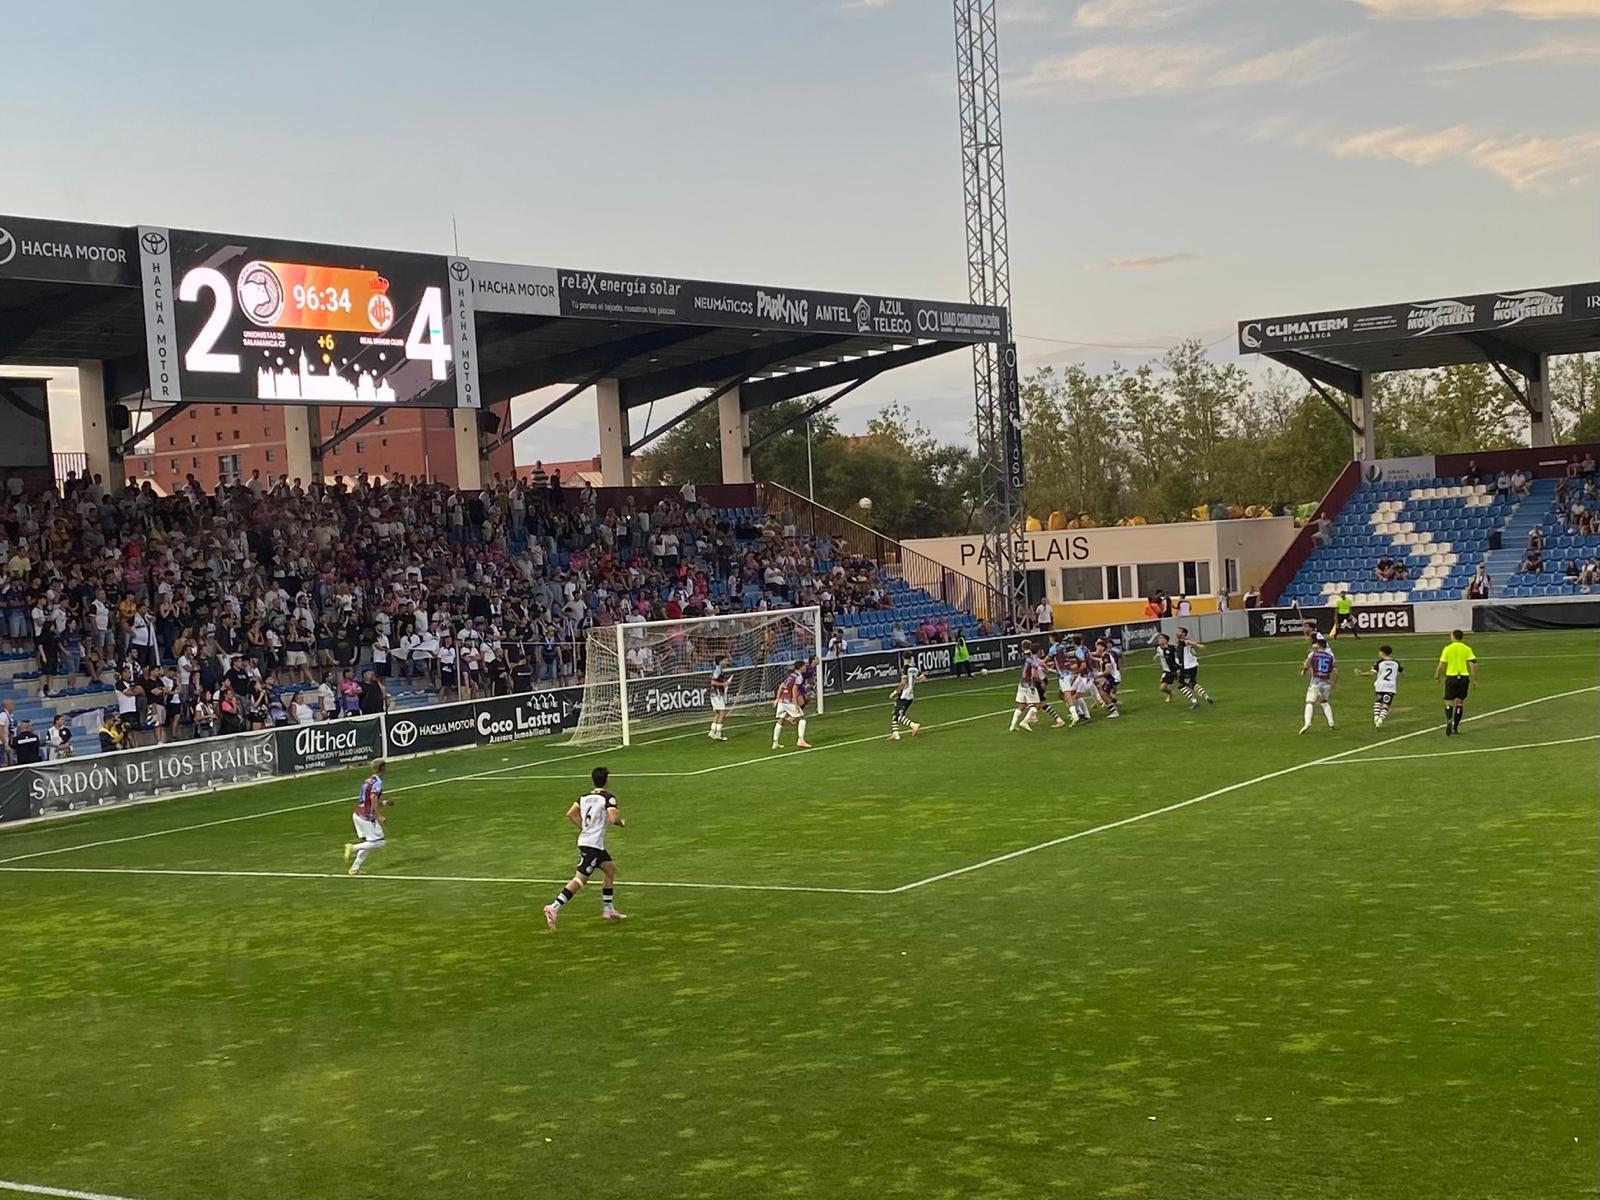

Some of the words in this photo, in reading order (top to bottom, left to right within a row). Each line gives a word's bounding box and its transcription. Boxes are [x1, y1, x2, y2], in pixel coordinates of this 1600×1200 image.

[22, 240, 73, 259] HACHA
[76, 246, 127, 263] MOTOR
[152, 262, 165, 325] HACHA
[478, 280, 516, 295] HACHA
[518, 283, 556, 298] MOTOR
[561, 273, 599, 296] relaX
[600, 277, 646, 297] energía
[650, 282, 681, 296] solar
[292, 284, 352, 313] 96:34
[694, 295, 753, 315] NEUMÁTICOS
[879, 299, 905, 317] AZUL
[179, 266, 240, 373] 2
[458, 288, 468, 342] HACHA
[1407, 312, 1475, 329] MONTSERRAT
[1493, 303, 1564, 321] MONTSERRAT
[405, 286, 452, 381] 4
[873, 317, 912, 334] TELECO
[1266, 317, 1349, 337] CLIMATERM
[317, 334, 335, 350] +6
[1283, 331, 1332, 343] SALAMANCA
[156, 334, 169, 396] MOTOR
[462, 350, 472, 403] MOTOR
[917, 649, 951, 670] FLOYMA
[1383, 667, 1393, 681] 2
[645, 684, 708, 712] Flexicar
[419, 722, 447, 736] HACHA
[447, 718, 475, 732] MOTOR
[477, 711, 514, 736] Coco
[516, 706, 561, 729] Lastra
[32, 763, 119, 801] SARDÓN
[127, 760, 151, 786] DE
[159, 752, 193, 780] LOS
[200, 743, 274, 773] FRAILES
[585, 805, 592, 827] 6
